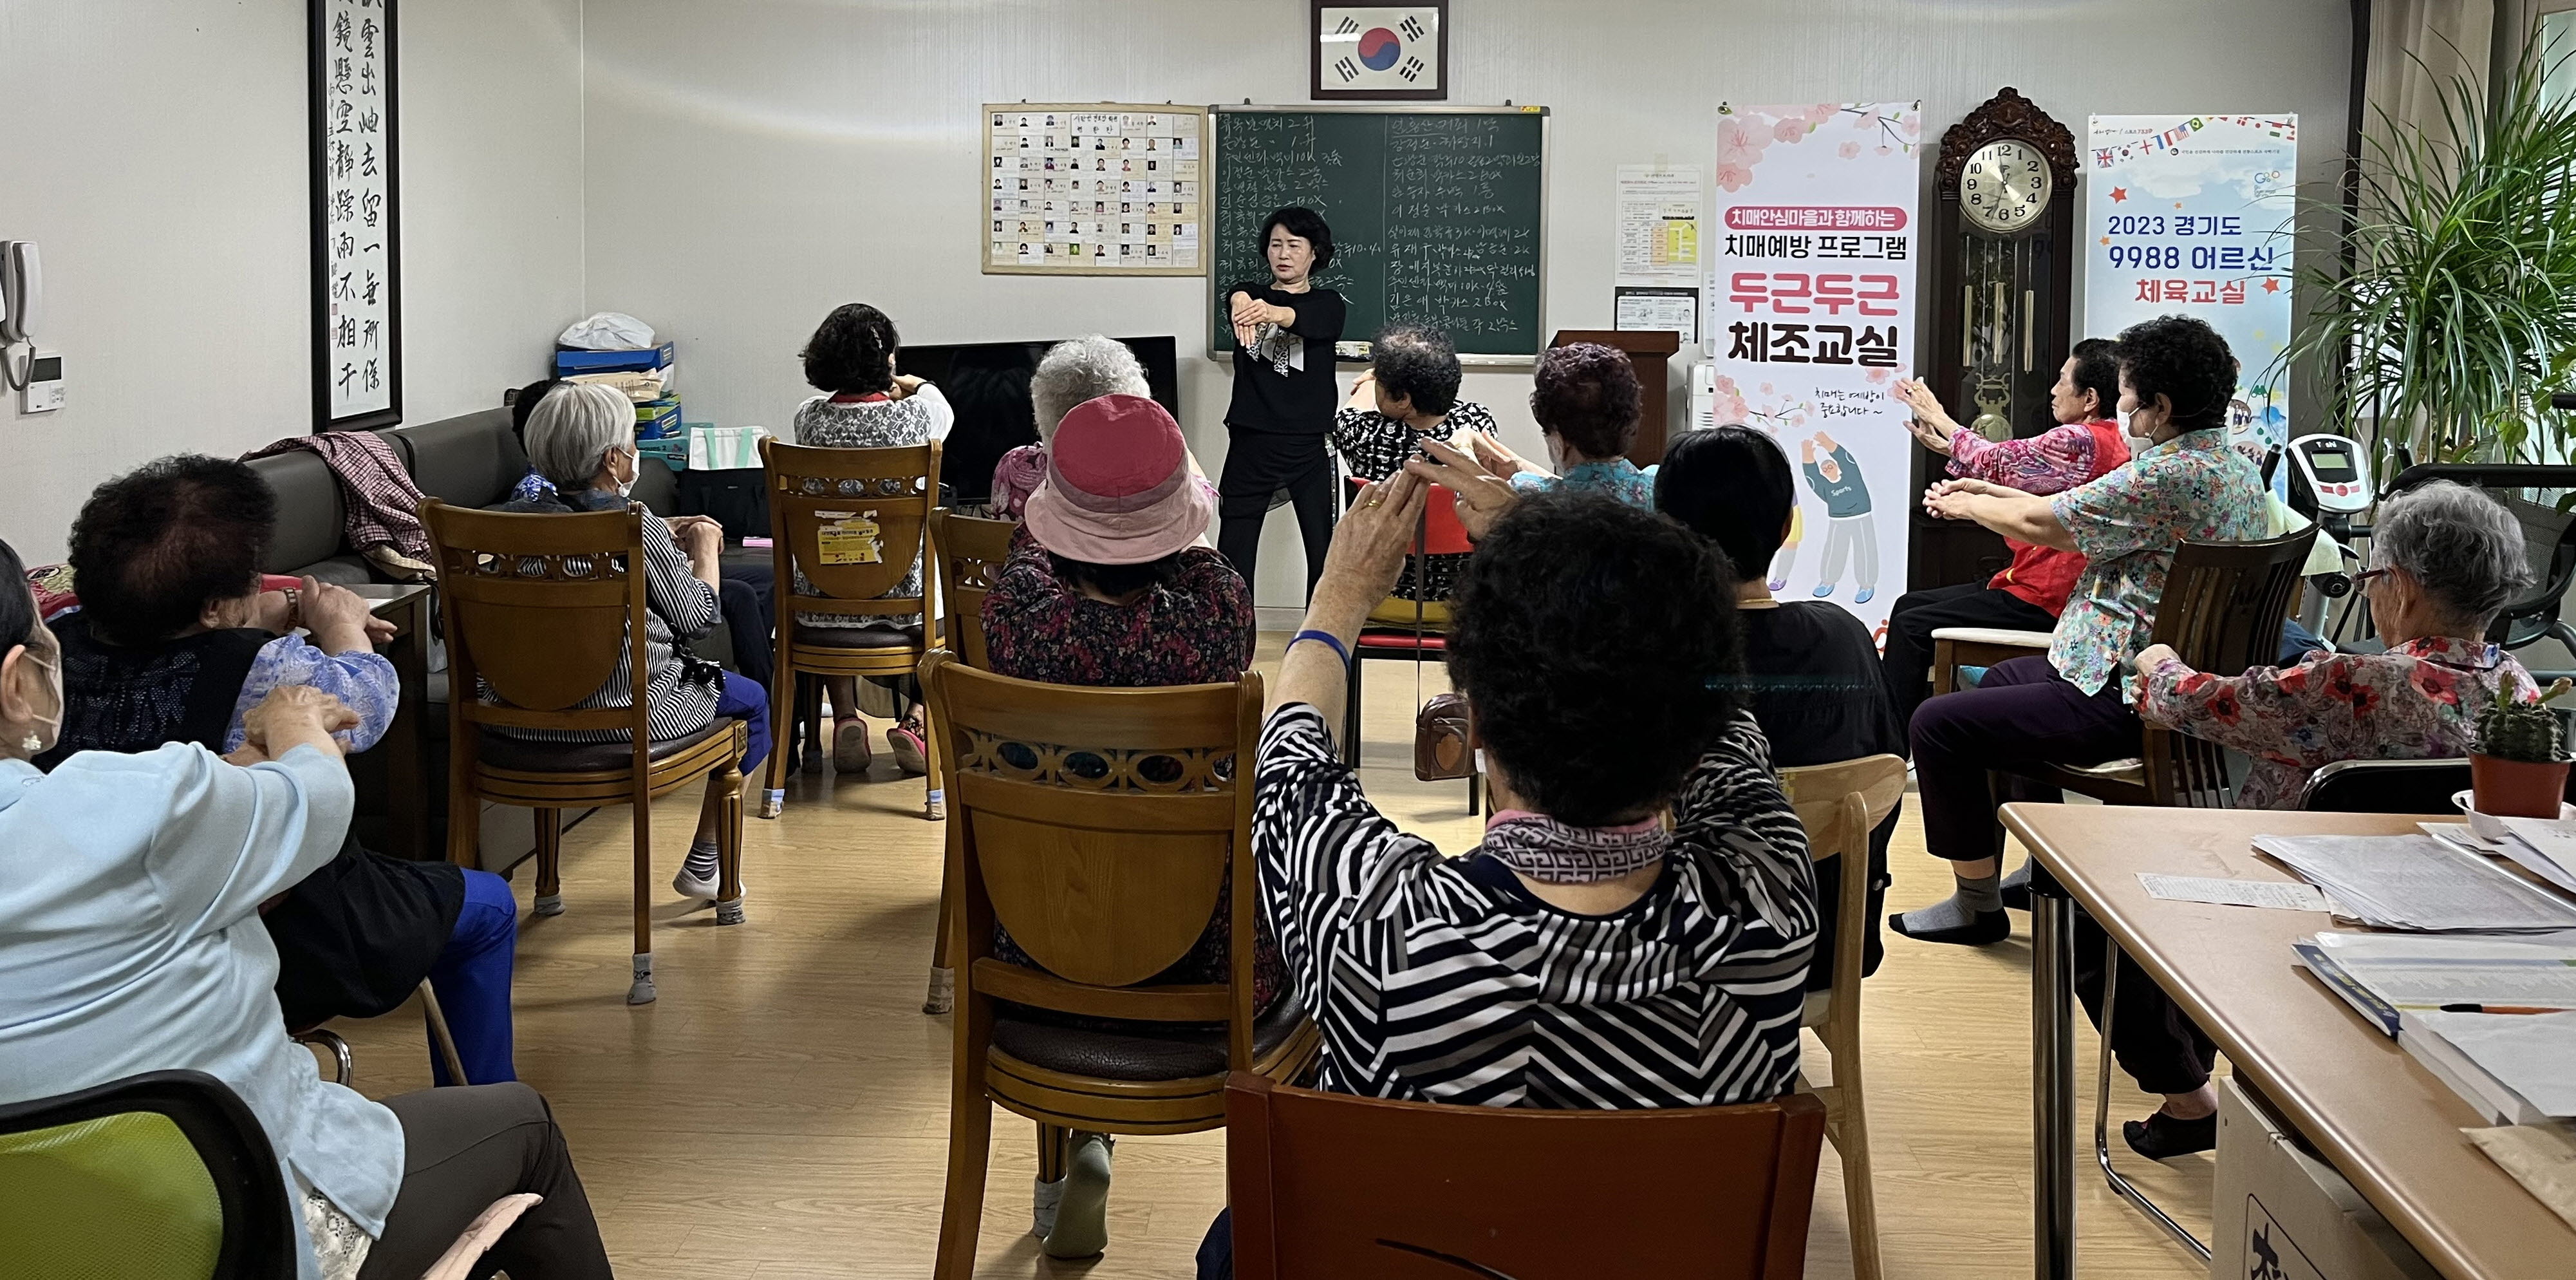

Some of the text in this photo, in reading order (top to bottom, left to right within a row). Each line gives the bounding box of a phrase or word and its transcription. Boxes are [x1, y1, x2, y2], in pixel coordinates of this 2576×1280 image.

[1982, 150, 1992, 160] 11
[1997, 145, 2011, 156] 12
[2018, 149, 2022, 160] 1
[1970, 163, 1982, 174] 10
[2028, 161, 2039, 172] 2
[1966, 179, 1977, 190] 9
[2031, 176, 2042, 189] 3
[1970, 193, 1982, 205] 8
[2026, 193, 2037, 203] 4
[1983, 206, 1994, 217] 7
[1999, 209, 2010, 220] 6
[2014, 205, 2026, 217] 5
[1731, 209, 1896, 228] 치매안심마을과 함께하는
[2108, 216, 2243, 236] 2023 경기도
[1725, 234, 1907, 261] 치매예방 프로그램
[2109, 245, 2273, 272] 9988 어르신
[1729, 272, 1900, 317] 두근두근
[2134, 278, 2246, 305] 체육교실
[1728, 321, 1898, 368] 체조교실
[1815, 386, 1885, 404] 치매는 예방이
[1820, 402, 1869, 418] 중요합니다
[1830, 485, 1853, 498] Sports
